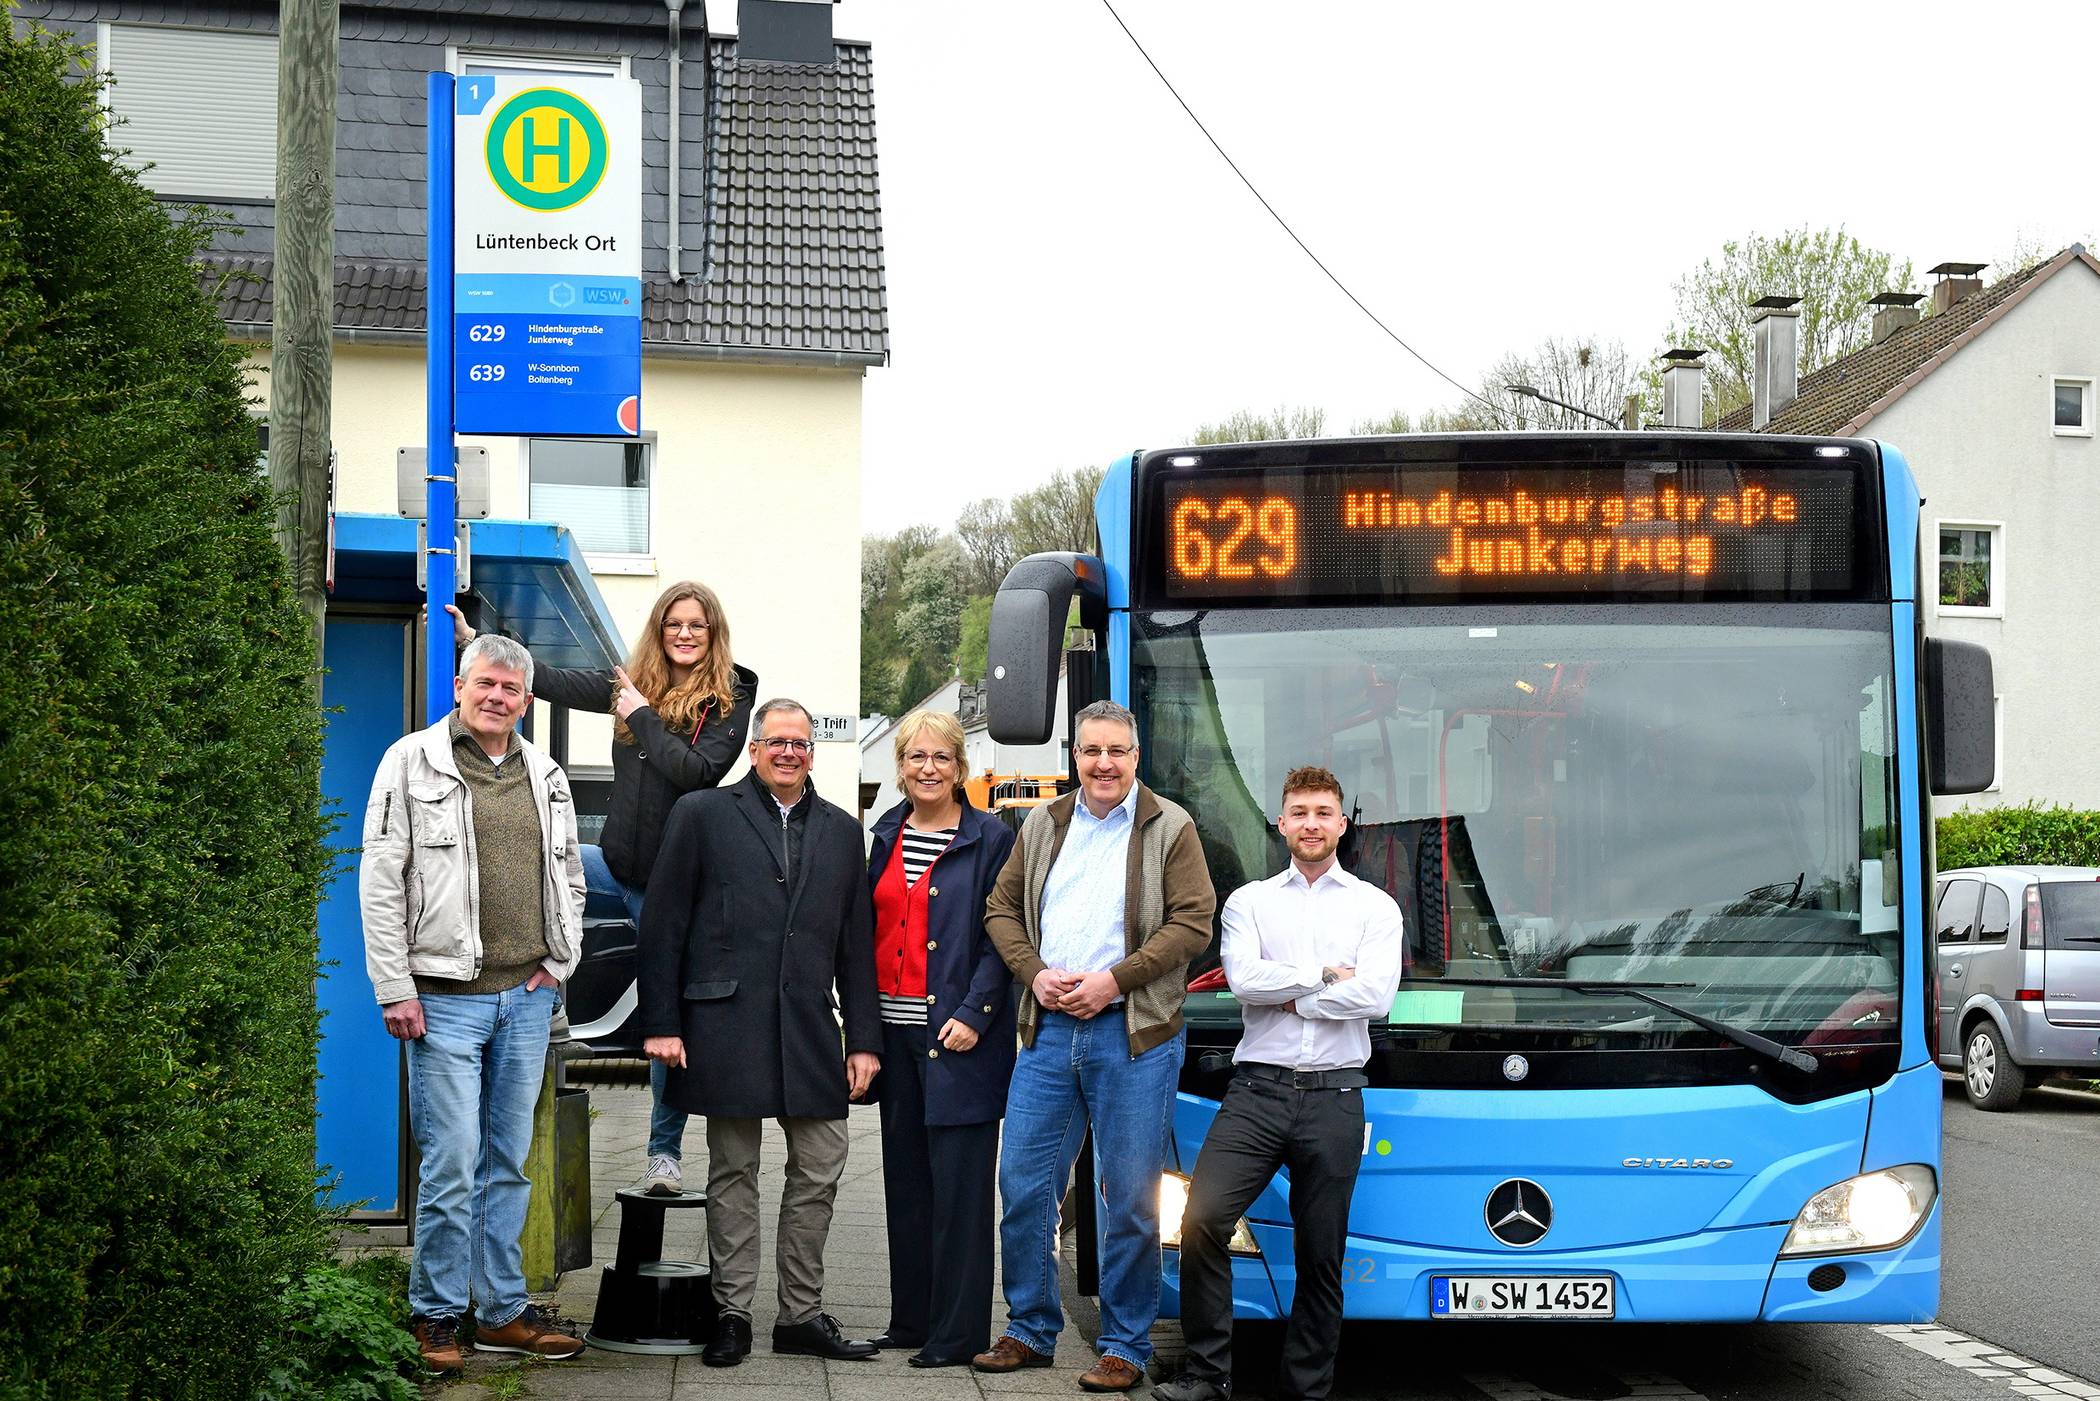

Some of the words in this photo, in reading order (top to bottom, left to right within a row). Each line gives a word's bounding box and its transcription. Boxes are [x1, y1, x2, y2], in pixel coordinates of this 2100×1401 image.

[469, 84, 478, 99] 1
[522, 117, 570, 183] H
[476, 233, 579, 251] Lüntenbeck
[585, 234, 616, 252] Ort
[586, 288, 621, 303] WSW
[469, 324, 506, 342] 629
[528, 324, 604, 336] Hindenburgstraße
[527, 335, 574, 346] Junkerweg
[469, 364, 506, 382] 639
[528, 375, 573, 386] Boltenberg
[1344, 488, 1797, 528] Hindenburgstraße
[1172, 496, 1298, 579] 629
[1435, 527, 1713, 575] Junkerweg
[823, 717, 847, 729] Trift
[823, 731, 834, 739] 38
[1621, 1157, 1735, 1169] CITARO
[1438, 1299, 1445, 1308] D
[1451, 1282, 1469, 1310] W
[1491, 1282, 1528, 1310] SW
[1536, 1282, 1609, 1310] 1452
